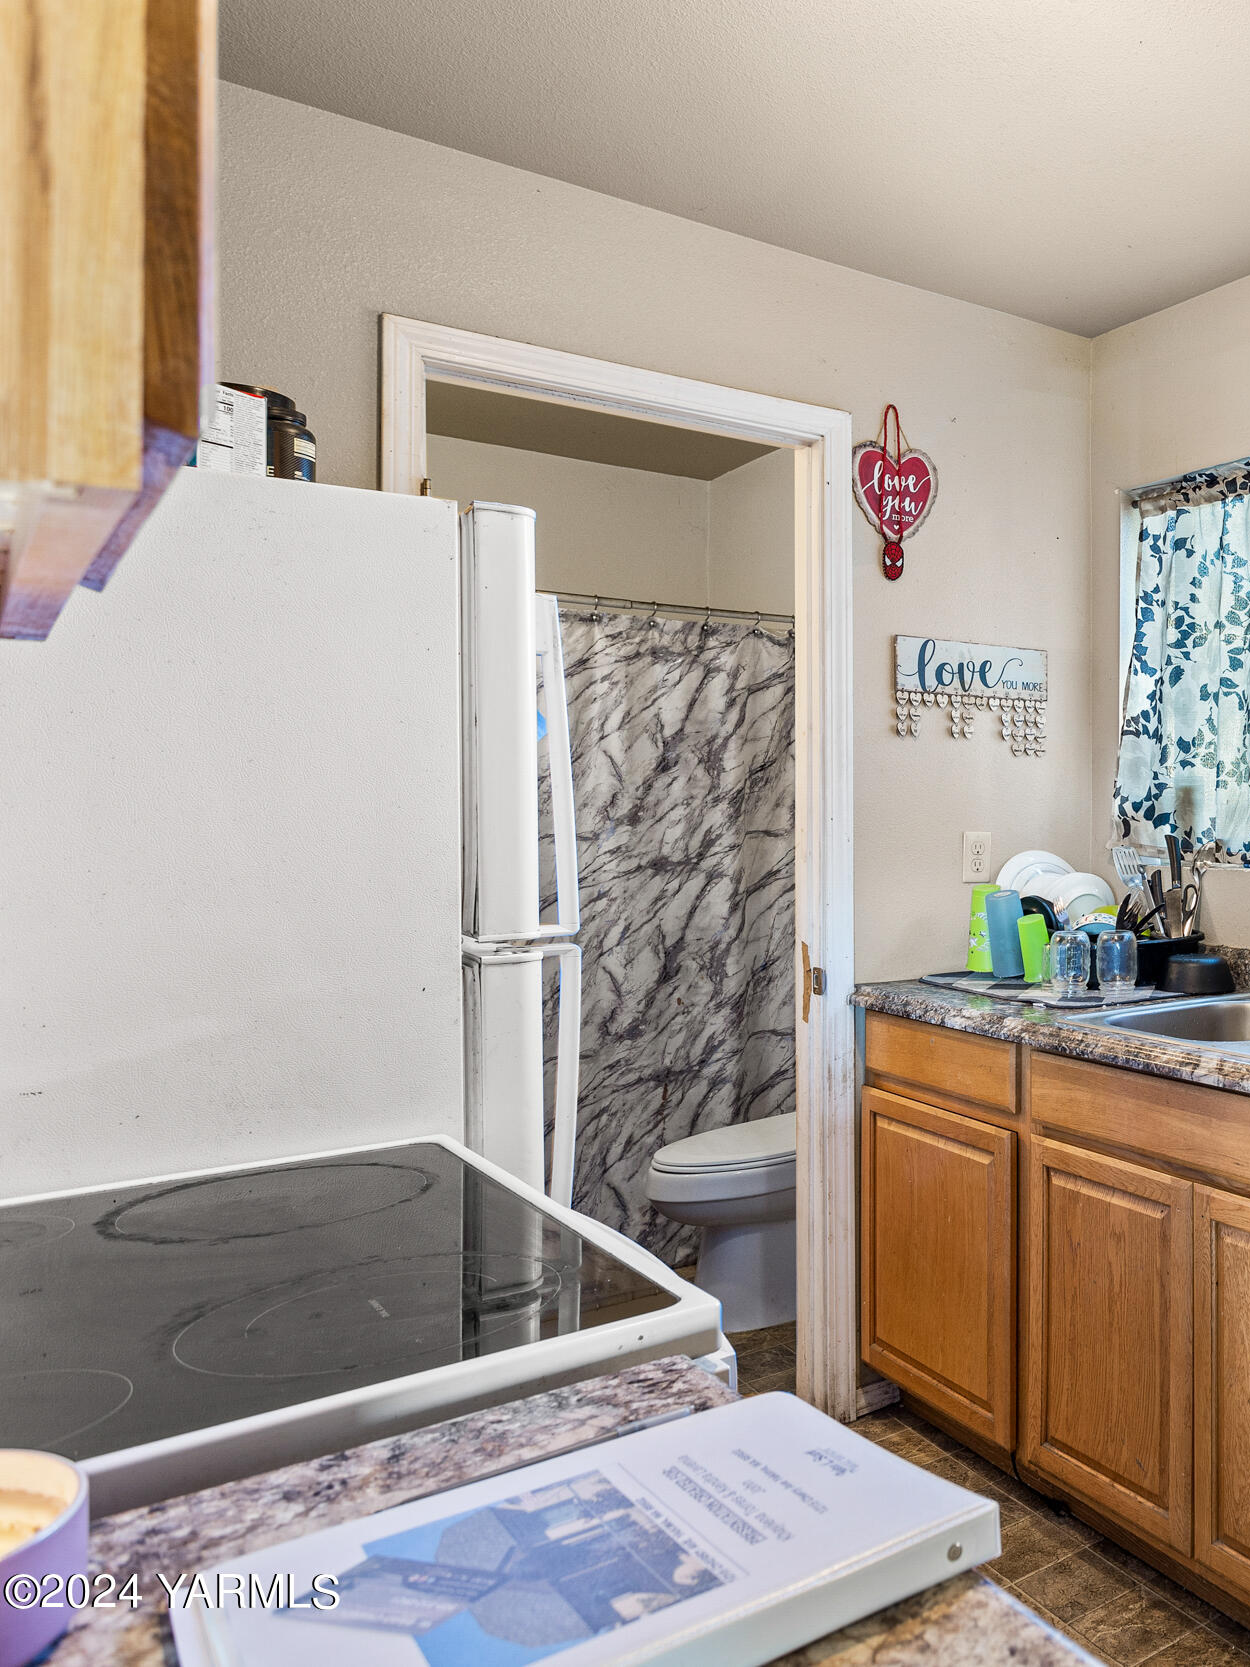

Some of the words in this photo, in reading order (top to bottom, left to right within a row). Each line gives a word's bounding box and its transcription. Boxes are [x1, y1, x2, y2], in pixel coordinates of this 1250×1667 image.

[862, 461, 931, 494] love
[897, 639, 1024, 693] love
[1001, 680, 1018, 690] YOU
[1022, 681, 1044, 693] MORE
